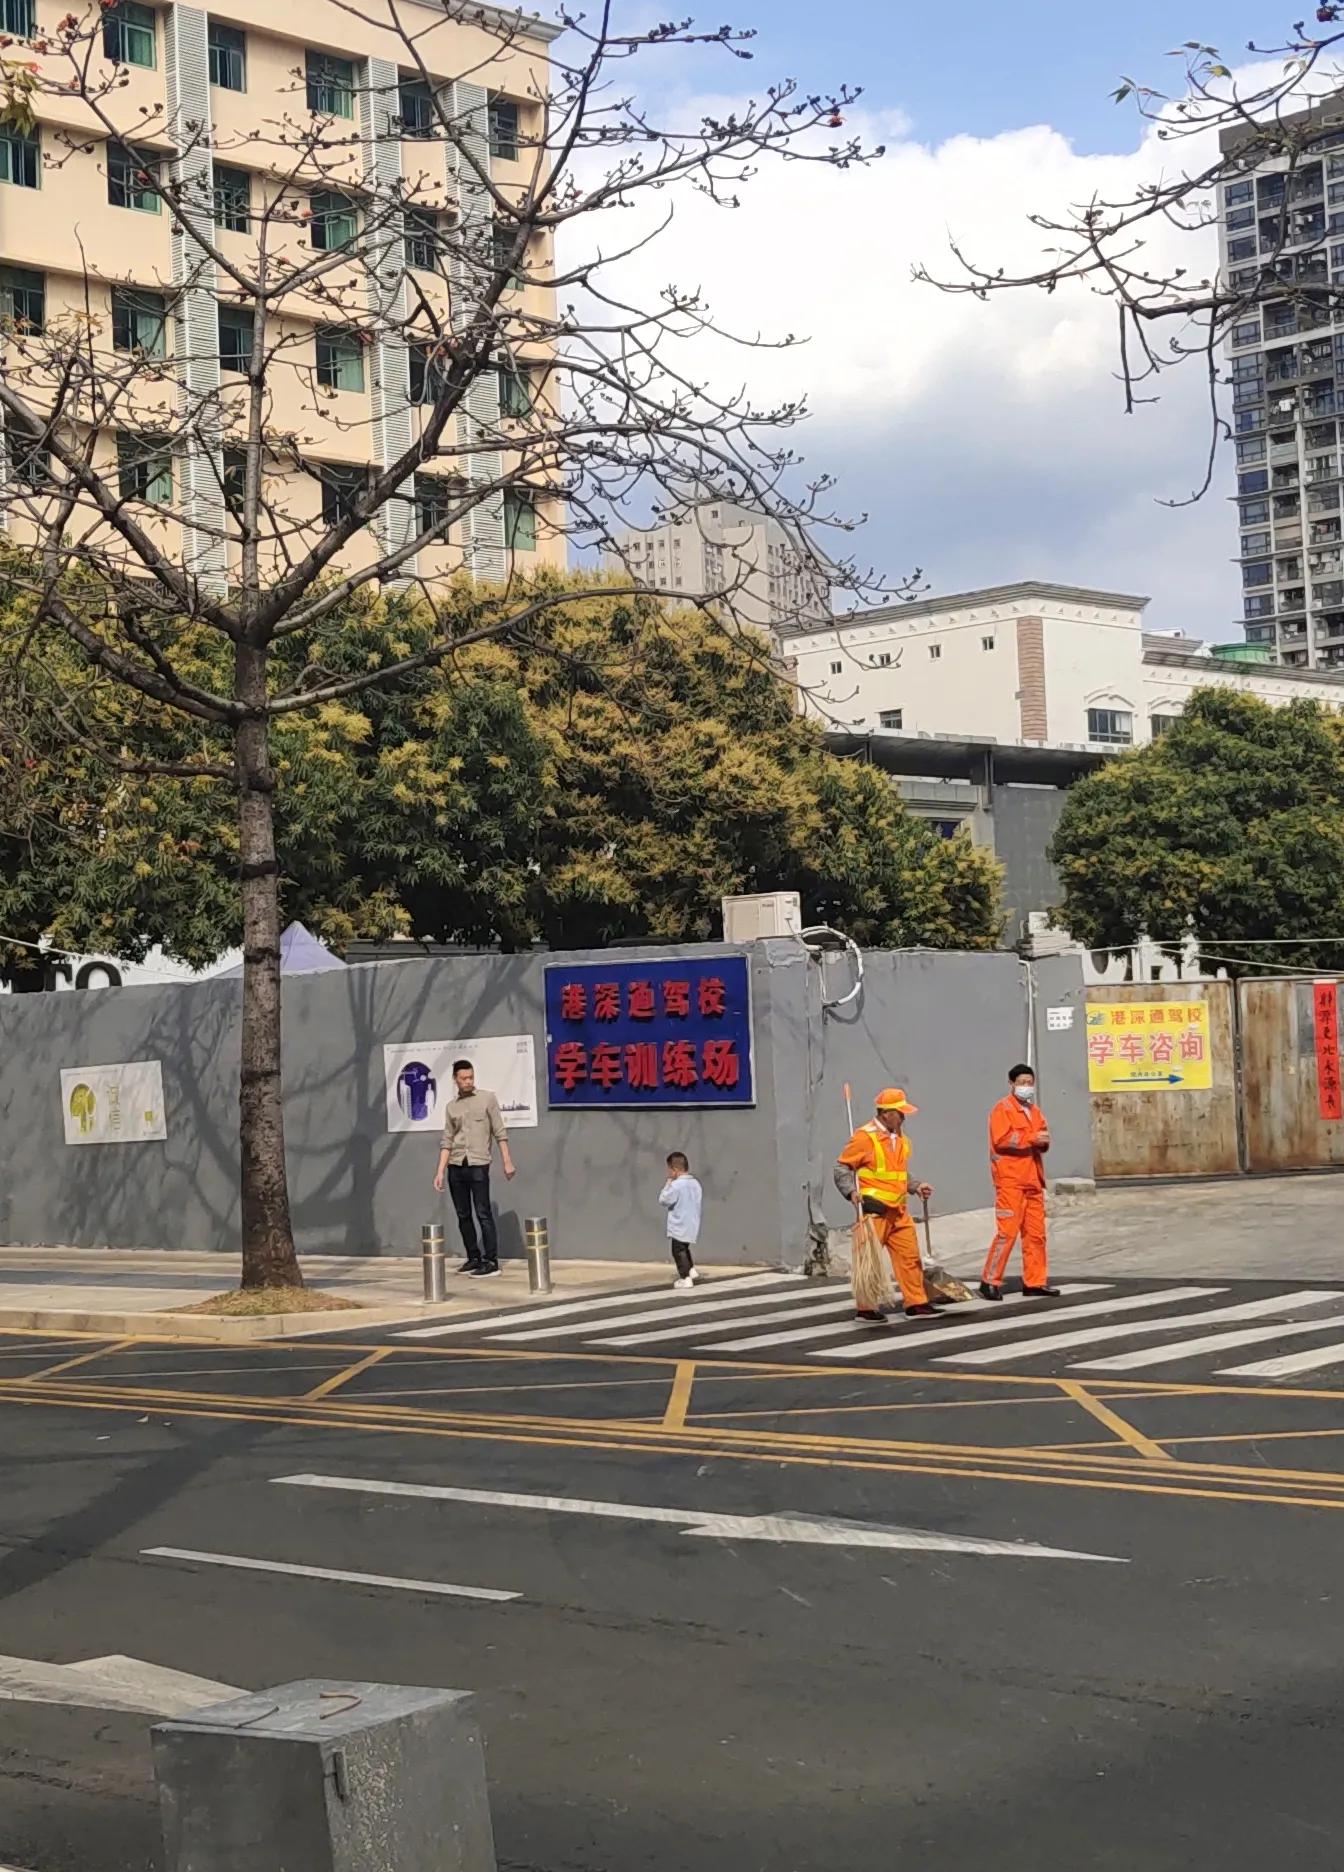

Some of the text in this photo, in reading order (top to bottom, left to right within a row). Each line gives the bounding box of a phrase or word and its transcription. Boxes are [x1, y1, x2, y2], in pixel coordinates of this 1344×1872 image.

[561, 976, 727, 1020] 港深通驾校
[1110, 1007, 1203, 1026] 港深通驾校
[555, 1039, 740, 1090] 学车训练场
[1087, 1031, 1205, 1066] 学车咨询
